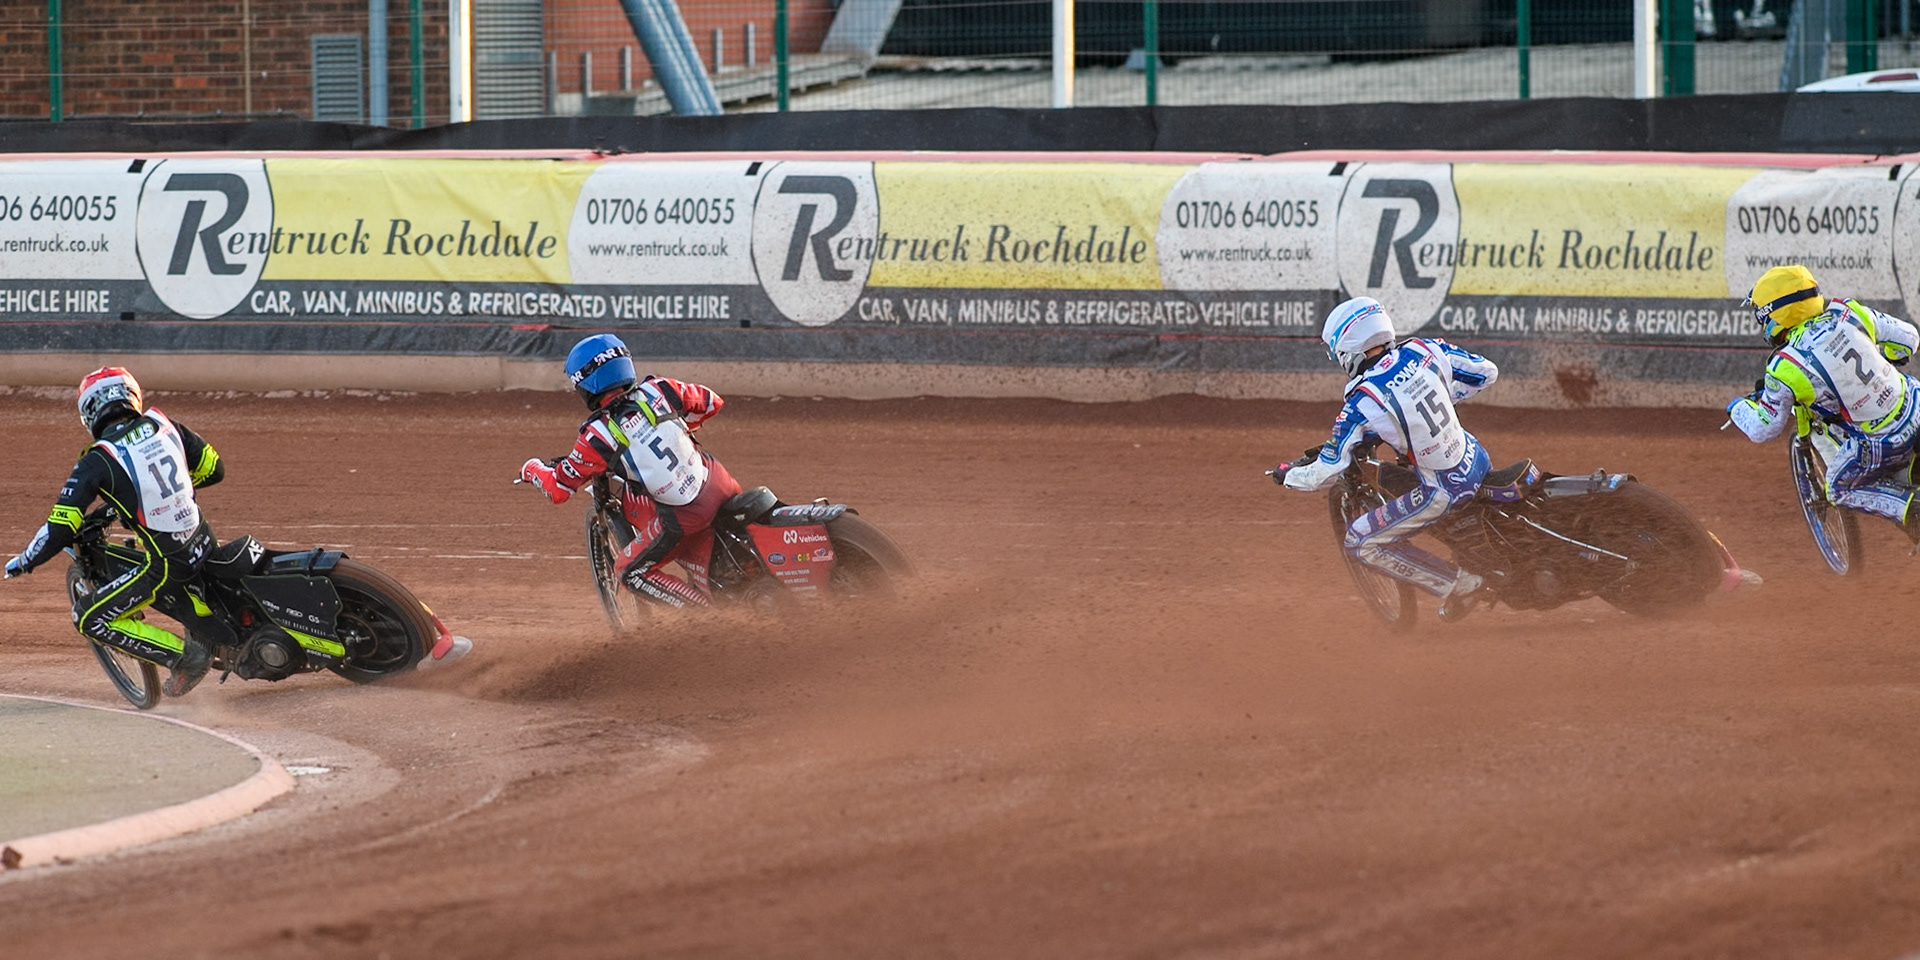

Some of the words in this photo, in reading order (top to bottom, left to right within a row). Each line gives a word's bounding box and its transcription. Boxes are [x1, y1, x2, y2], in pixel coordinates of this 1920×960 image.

[30, 195, 117, 221] 640055
[587, 198, 648, 225] 01706
[654, 197, 735, 225] 640055
[1176, 200, 1236, 228] 01706
[1242, 200, 1319, 228] 640055
[1738, 205, 1800, 234] 01706
[1806, 205, 1880, 234] 640055
[163, 173, 370, 275] Rentruck
[383, 218, 558, 259] Rochdale
[777, 175, 970, 281] Rentruck
[983, 223, 1147, 263] Rochdale
[1361, 178, 1546, 289] Rentruck
[1557, 229, 1714, 272] Rochdale
[588, 237, 729, 257] www.rentruck.co.uk
[1180, 241, 1313, 262] www.rentruck.co.uk
[1745, 250, 1875, 270] www.rentruck.co.uk
[65, 290, 109, 313] HIRE
[250, 290, 296, 317] CAR,
[302, 290, 350, 317] VAN,
[356, 290, 444, 315] MINIBUS
[448, 292, 463, 315] &
[468, 291, 607, 319] REFRIGERATED
[610, 295, 683, 319] VEHICLE
[688, 295, 730, 319] HIRE
[858, 297, 900, 326] CAR,
[903, 299, 951, 326] VAN,
[957, 299, 1041, 325] MINIBUS
[1045, 299, 1060, 324] &
[1064, 300, 1199, 325] REFRIGERATED
[1201, 301, 1270, 326] VEHICLE
[1274, 301, 1315, 326] HIRE
[1439, 307, 1481, 334] CAR,
[1485, 307, 1528, 335] VAN,
[1534, 307, 1613, 334] MINIBUS
[1615, 308, 1630, 333] &
[1634, 308, 1759, 336] REFRIGERATED
[1385, 359, 1418, 390] ROWE
[1842, 347, 1875, 386] 2
[1415, 389, 1451, 439] 15
[648, 435, 679, 472] 5
[1459, 437, 1477, 476] LINK
[147, 454, 185, 500] 12
[799, 534, 828, 543] Vehicles
